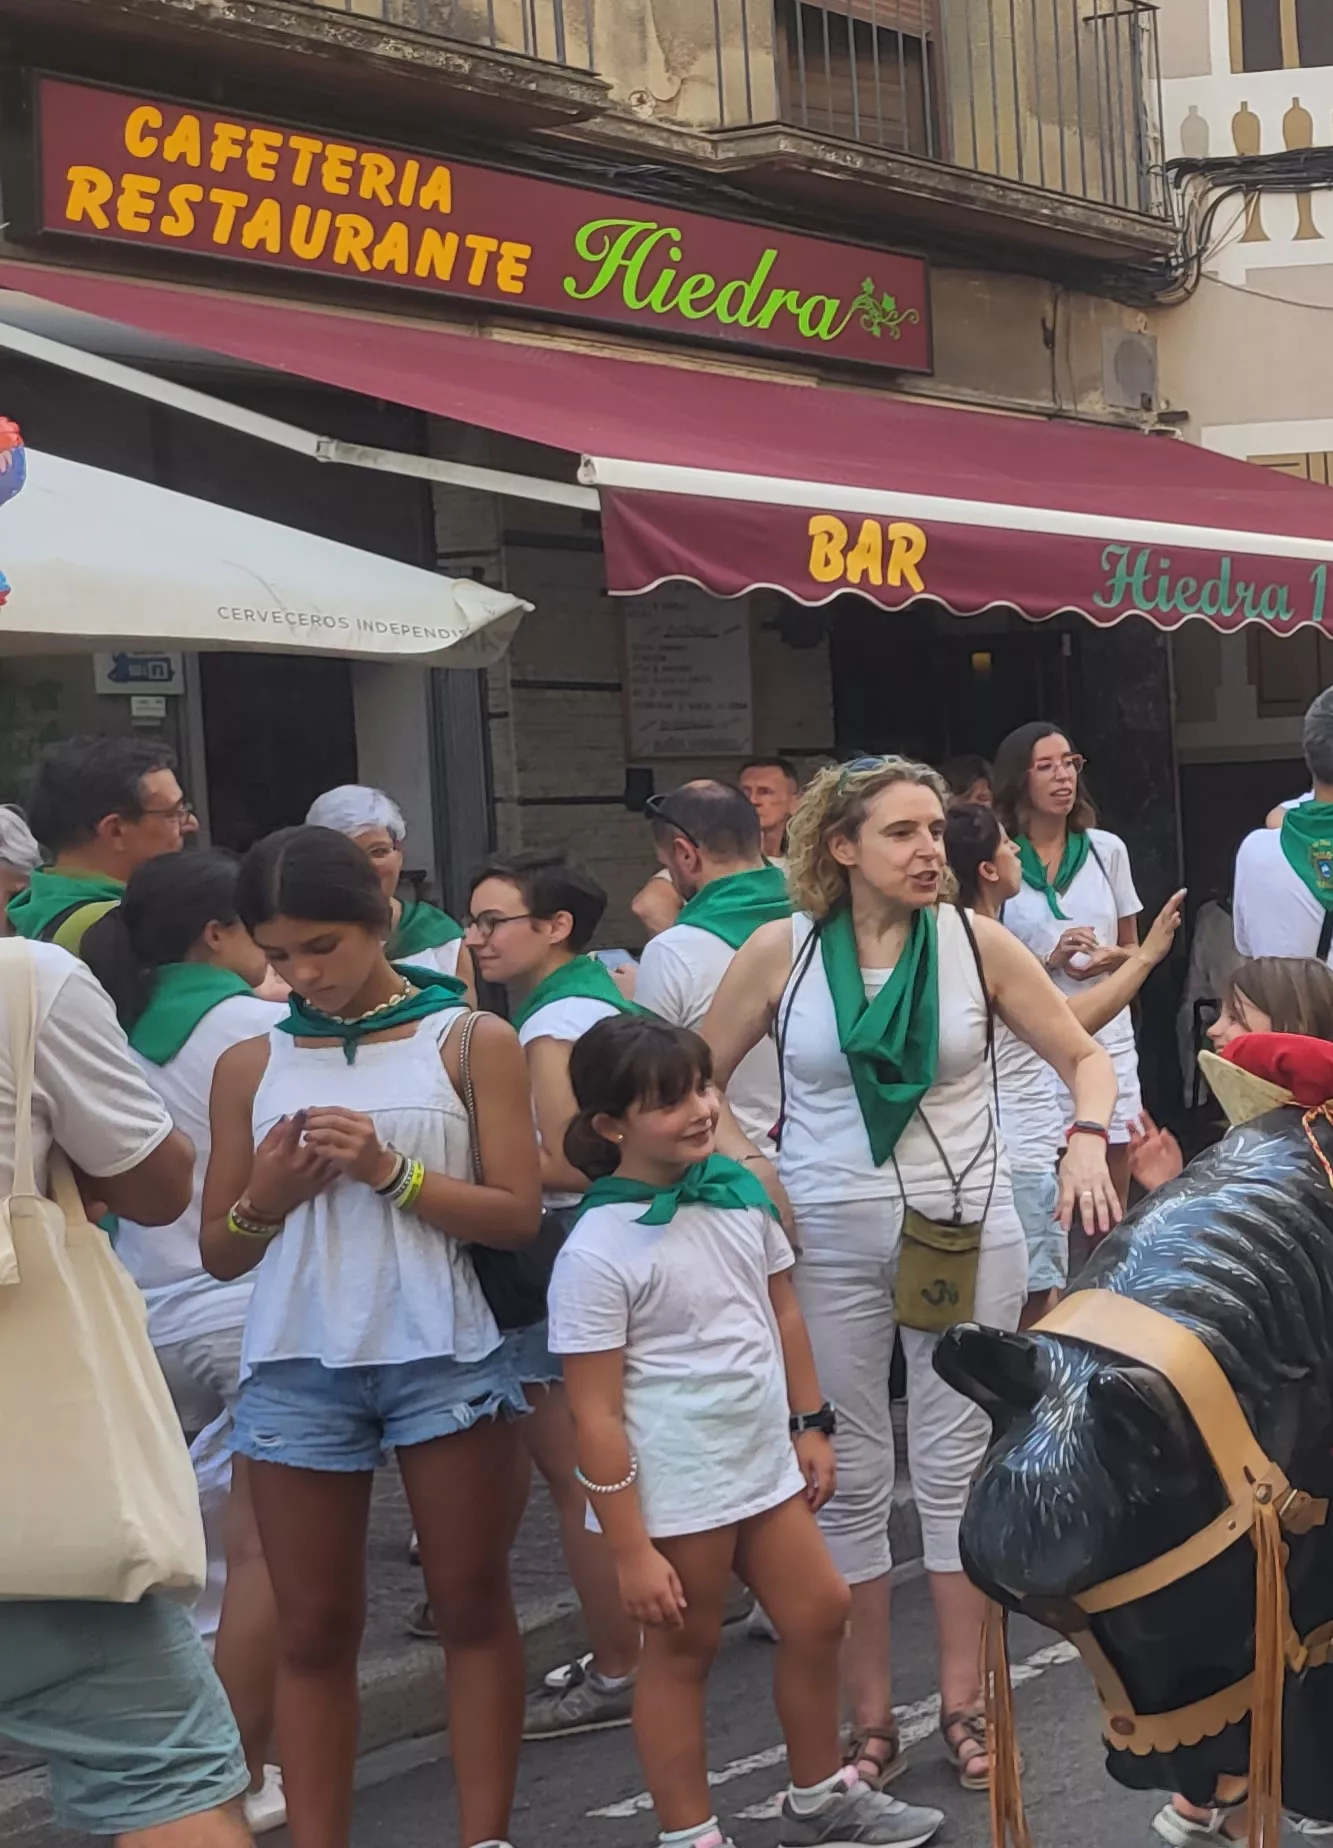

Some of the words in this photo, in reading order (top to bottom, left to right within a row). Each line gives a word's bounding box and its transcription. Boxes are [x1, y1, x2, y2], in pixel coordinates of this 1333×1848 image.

[124, 105, 453, 214] CAFETERIA
[65, 165, 533, 294] RESTAURANTE
[563, 219, 853, 340] Hiedra
[807, 514, 927, 593] BAR
[1093, 544, 1295, 622] Hiedra
[1310, 564, 1328, 622] 1
[216, 605, 350, 630] CERVECEROS
